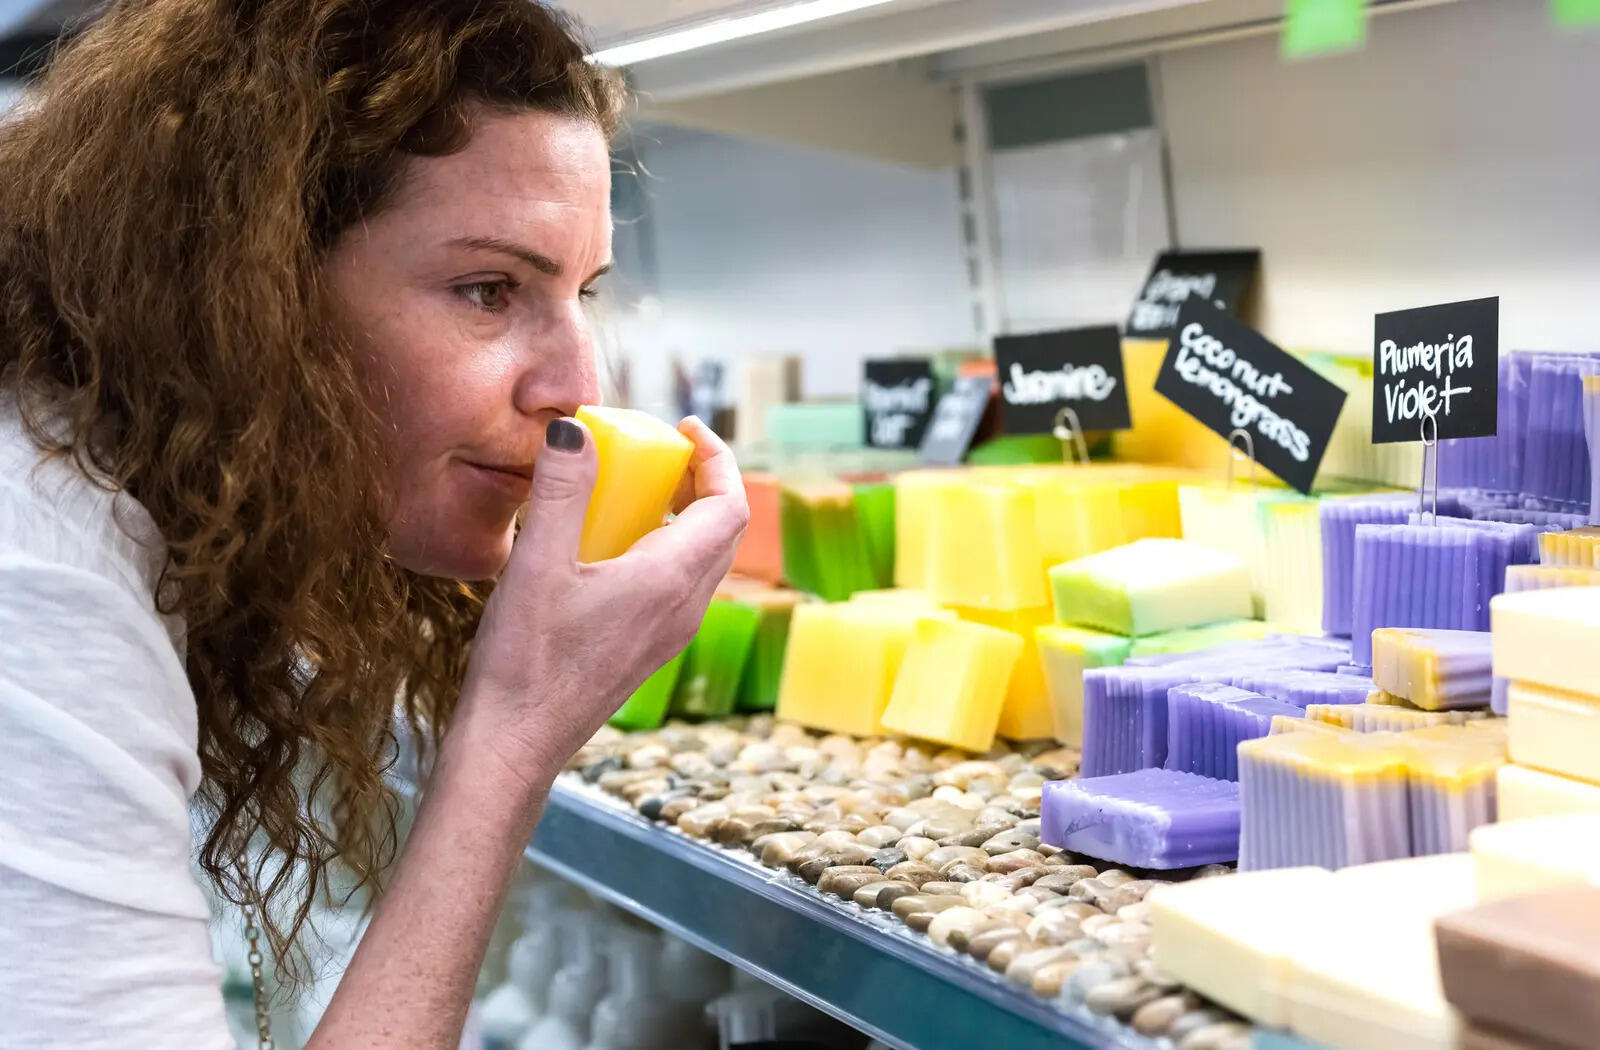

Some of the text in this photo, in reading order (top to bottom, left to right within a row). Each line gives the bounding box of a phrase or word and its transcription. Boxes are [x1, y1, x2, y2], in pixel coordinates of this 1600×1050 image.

[1180, 322, 1293, 398] Coconut
[1379, 333, 1474, 379] Plumeria
[1384, 374, 1472, 423] Violet
